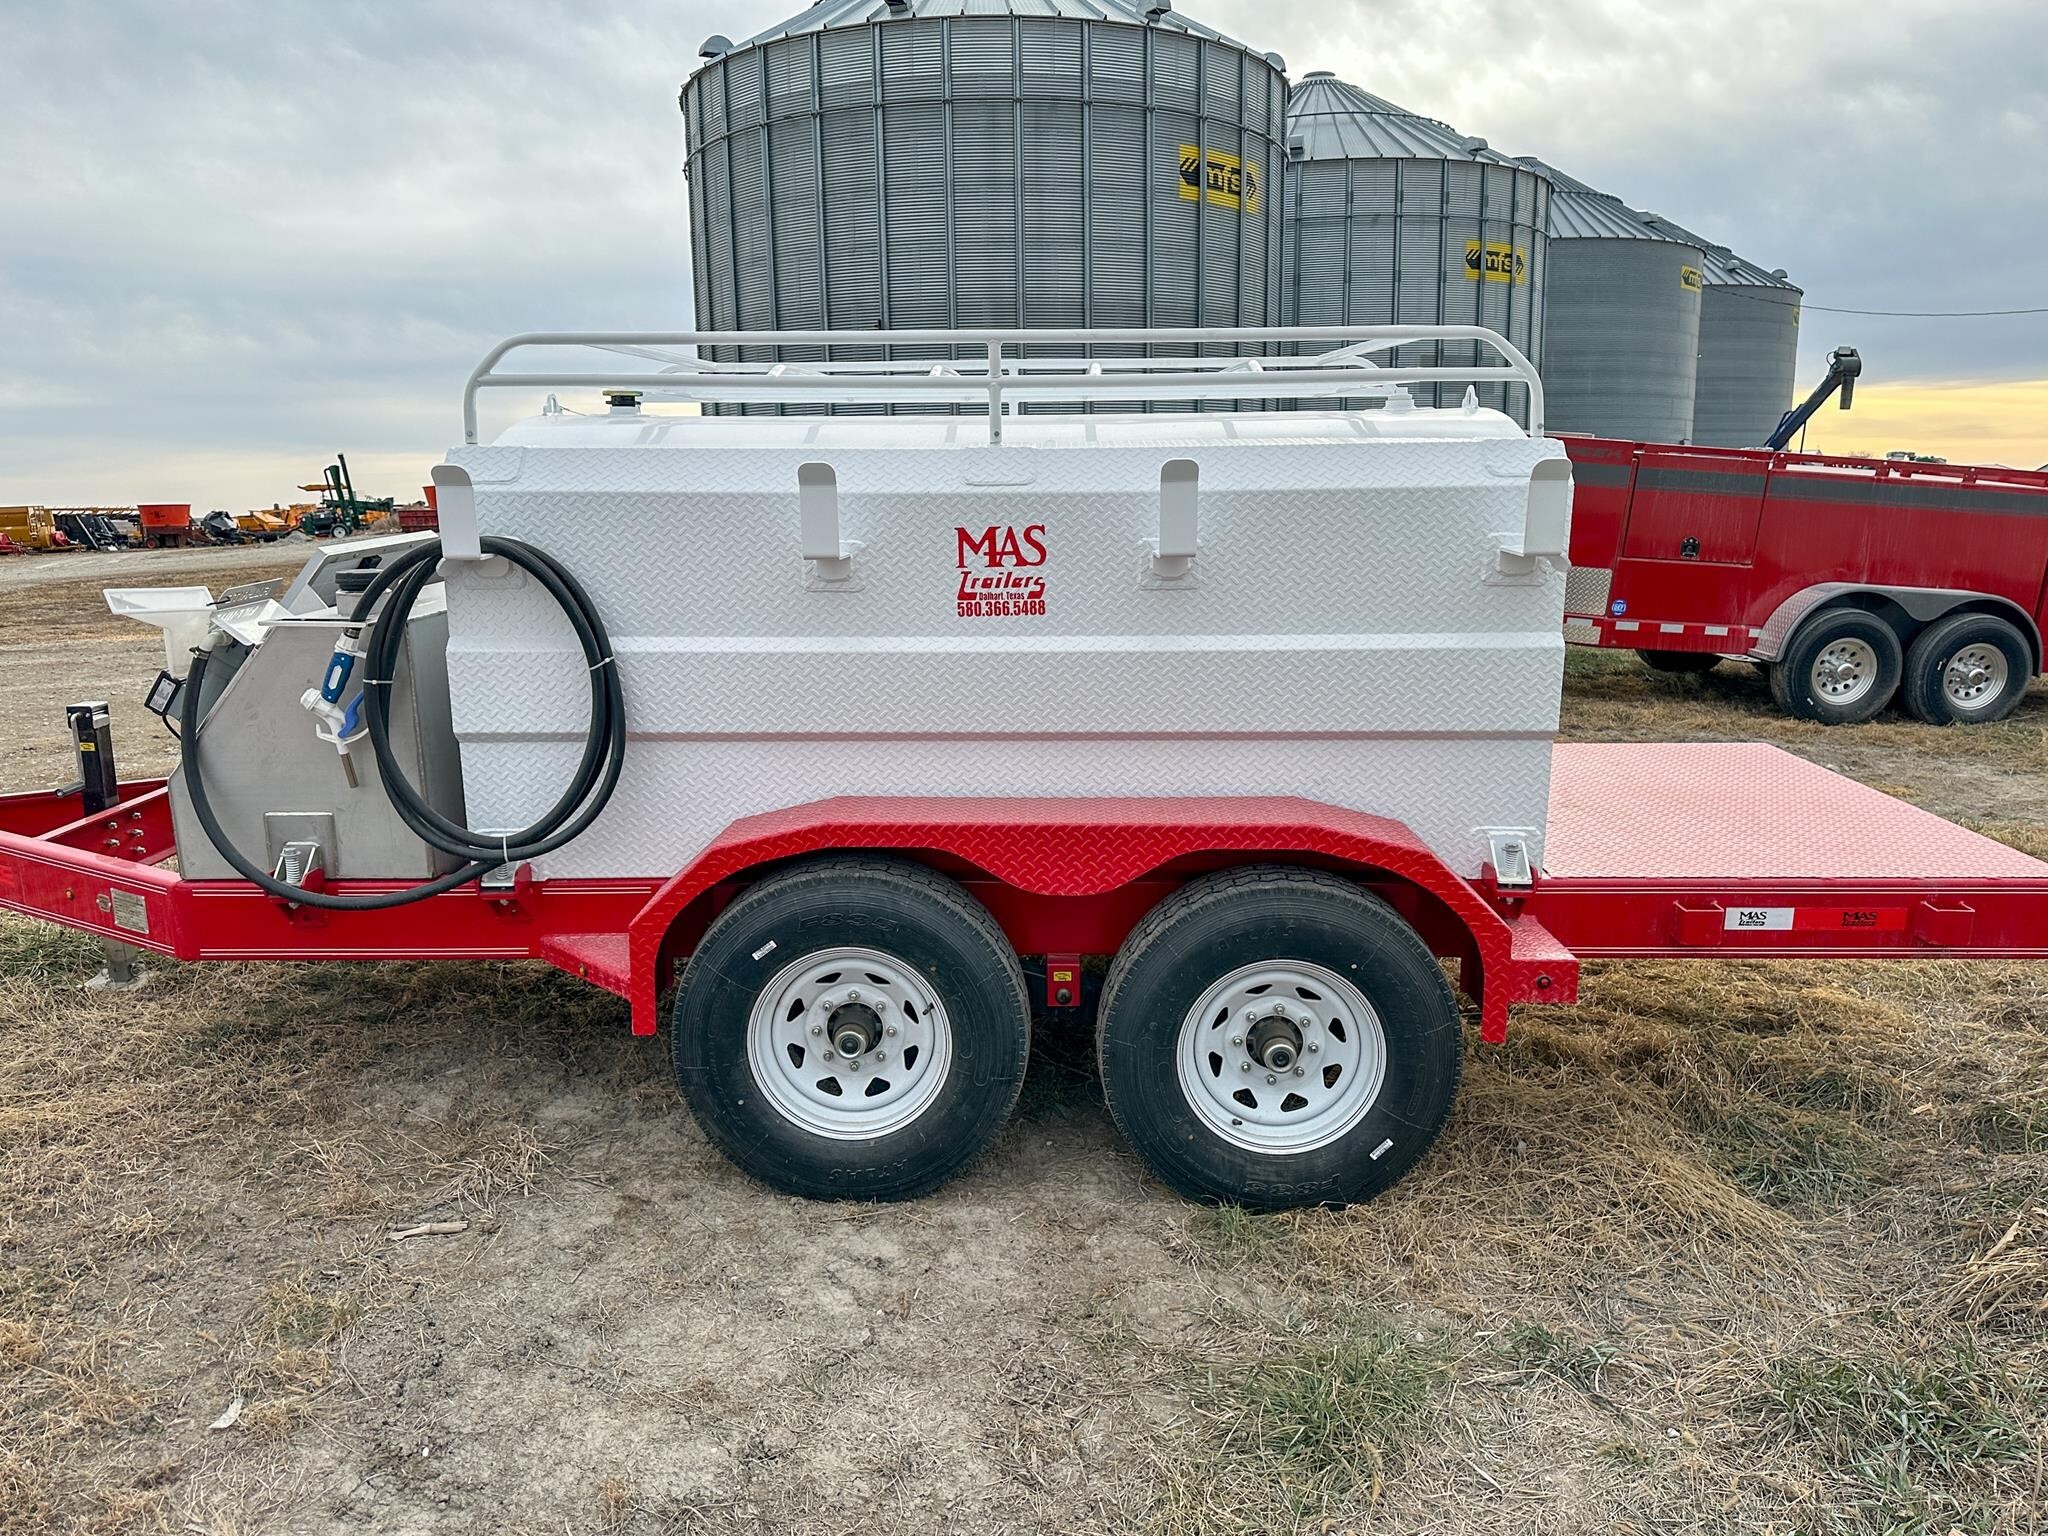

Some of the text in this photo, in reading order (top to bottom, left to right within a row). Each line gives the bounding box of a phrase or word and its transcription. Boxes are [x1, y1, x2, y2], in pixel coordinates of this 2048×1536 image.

[954, 524, 1047, 568] MAS
[957, 571, 1046, 600] Trailers
[1006, 591, 1025, 600] Texas
[957, 600, 1046, 617] 580.366.5488
[1739, 911, 1767, 920] MAS
[1842, 911, 1878, 920] MAS
